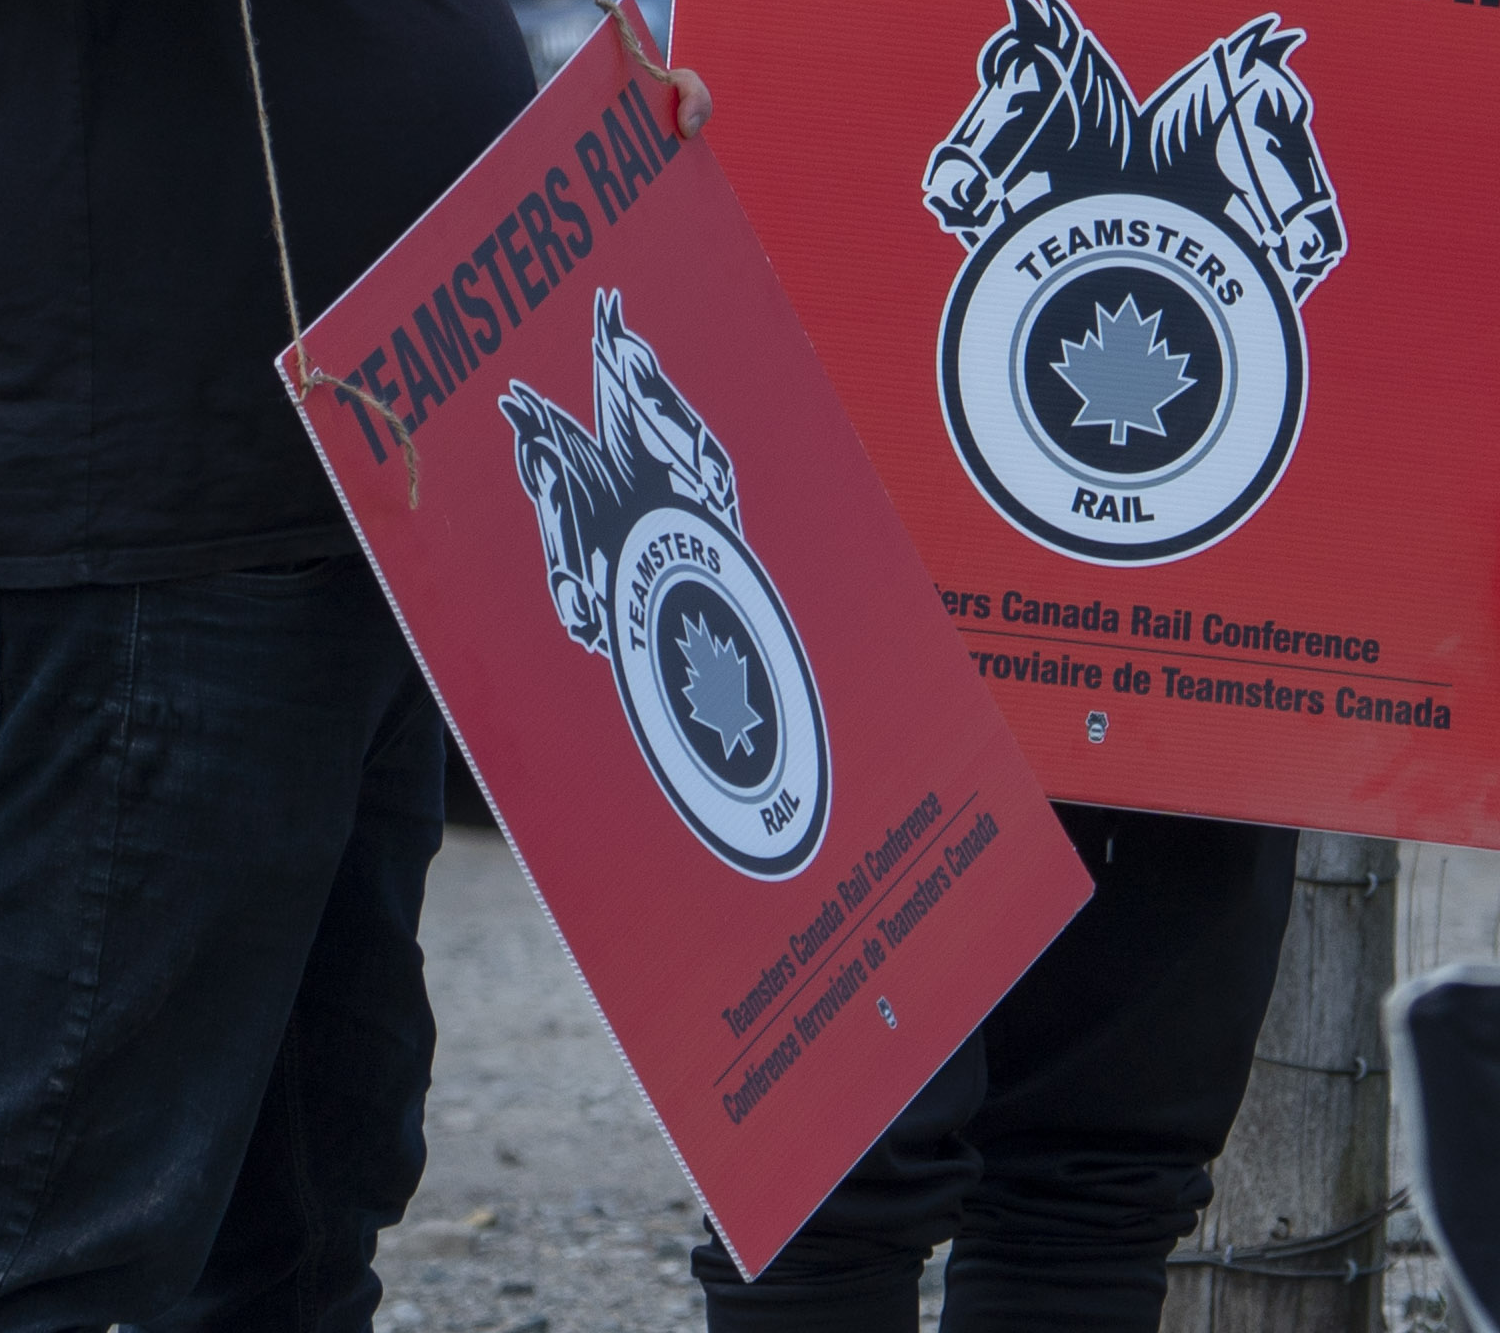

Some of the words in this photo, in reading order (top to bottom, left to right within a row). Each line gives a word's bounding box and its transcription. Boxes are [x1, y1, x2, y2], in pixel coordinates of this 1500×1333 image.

[334, 166, 593, 465] TEAMSTERS
[574, 78, 681, 226] RAIL
[1015, 219, 1243, 308] TEAMSTERS
[1071, 487, 1155, 524] RAIL
[629, 532, 721, 652] TEAMSTERS
[1002, 590, 1119, 633] Canada
[1131, 605, 1192, 641] Rail
[1202, 613, 1380, 663] Conference
[968, 651, 1102, 689] roviaire
[1112, 662, 1150, 695] de
[1161, 666, 1325, 715] Teamsters
[1335, 686, 1451, 730] Canada
[759, 788, 801, 836] RAIL
[721, 952, 796, 1039] Teamsters
[789, 899, 846, 966] Canada
[837, 862, 872, 913] Rail
[864, 791, 942, 882] Conference
[722, 1033, 803, 1126] Conférence
[794, 958, 868, 1047] ferroviaire
[862, 937, 886, 971] de
[876, 866, 952, 948] Teamsters
[944, 811, 999, 877] Canada
